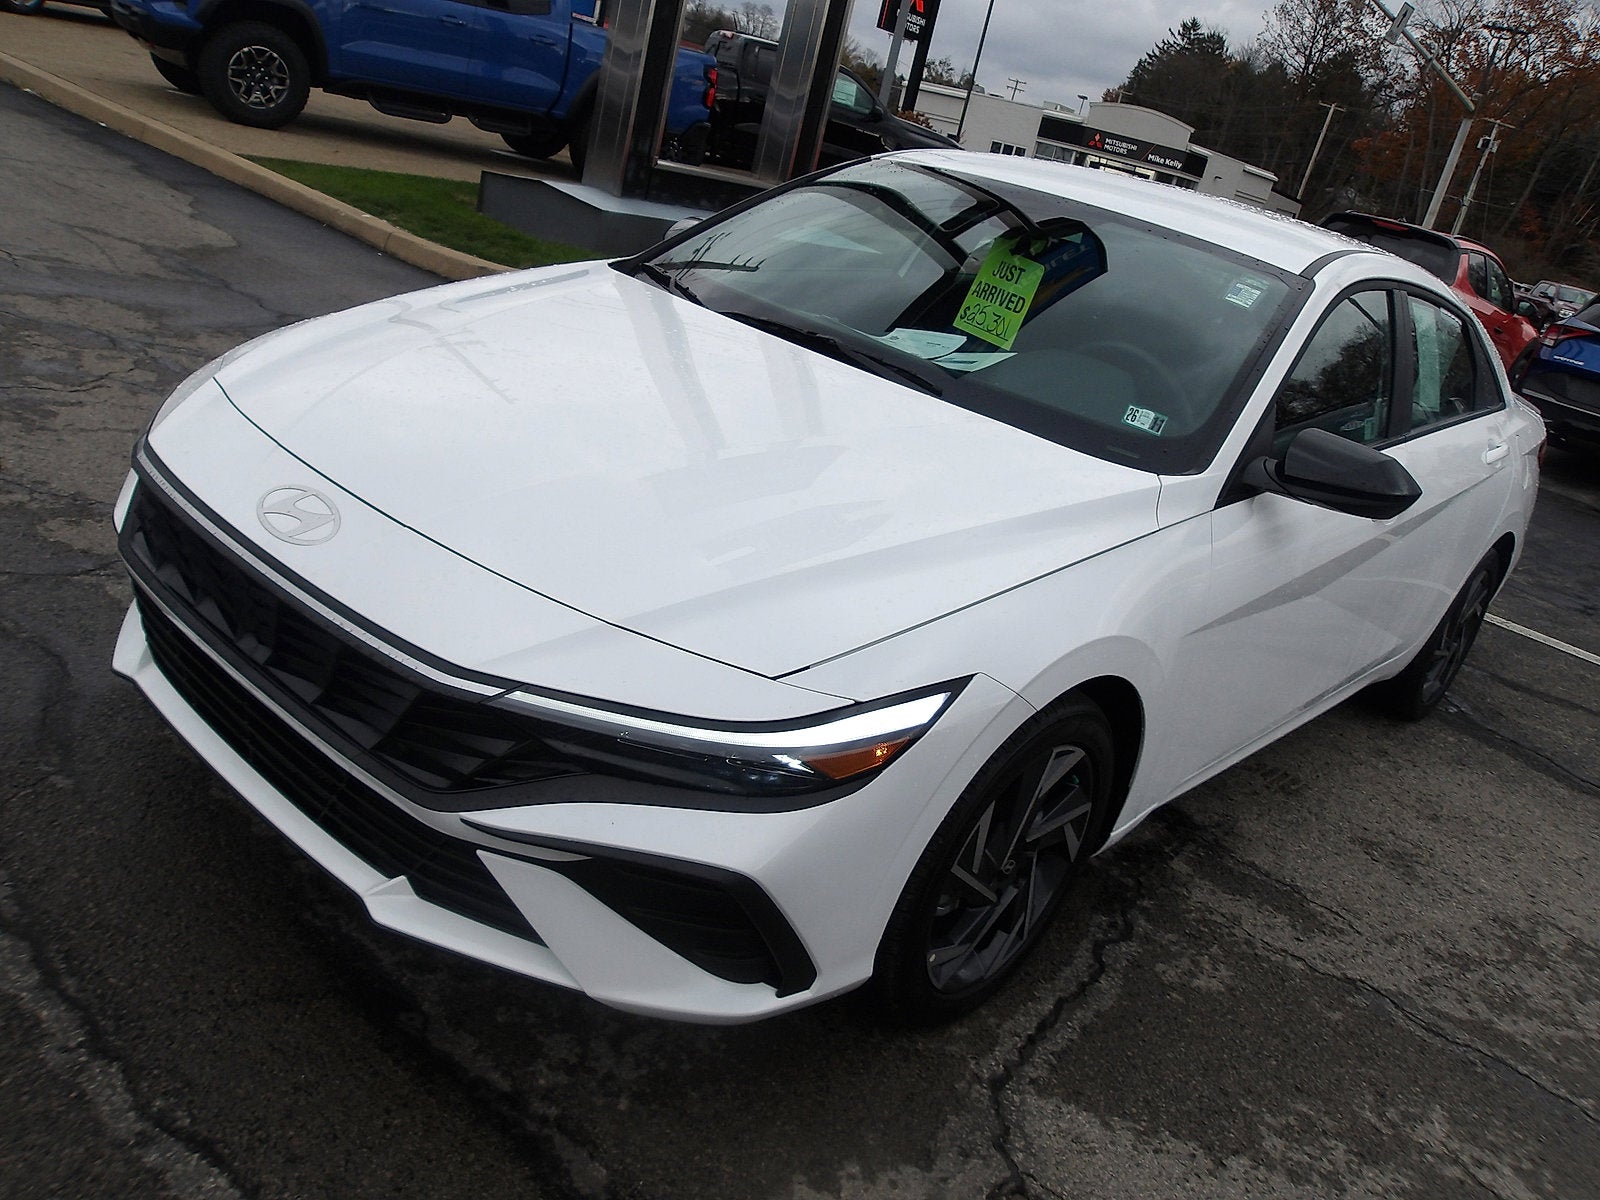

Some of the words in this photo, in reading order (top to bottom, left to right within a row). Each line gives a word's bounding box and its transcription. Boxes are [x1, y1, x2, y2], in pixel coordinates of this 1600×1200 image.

[1104, 144, 1128, 155] MOTORS
[1105, 138, 1137, 151] MITSUBISHI
[1147, 154, 1165, 165] Mike
[1165, 158, 1183, 169] Kelly
[992, 261, 1026, 285] JUST
[972, 280, 1026, 314] ARRIVED
[1125, 408, 1139, 423] 26
